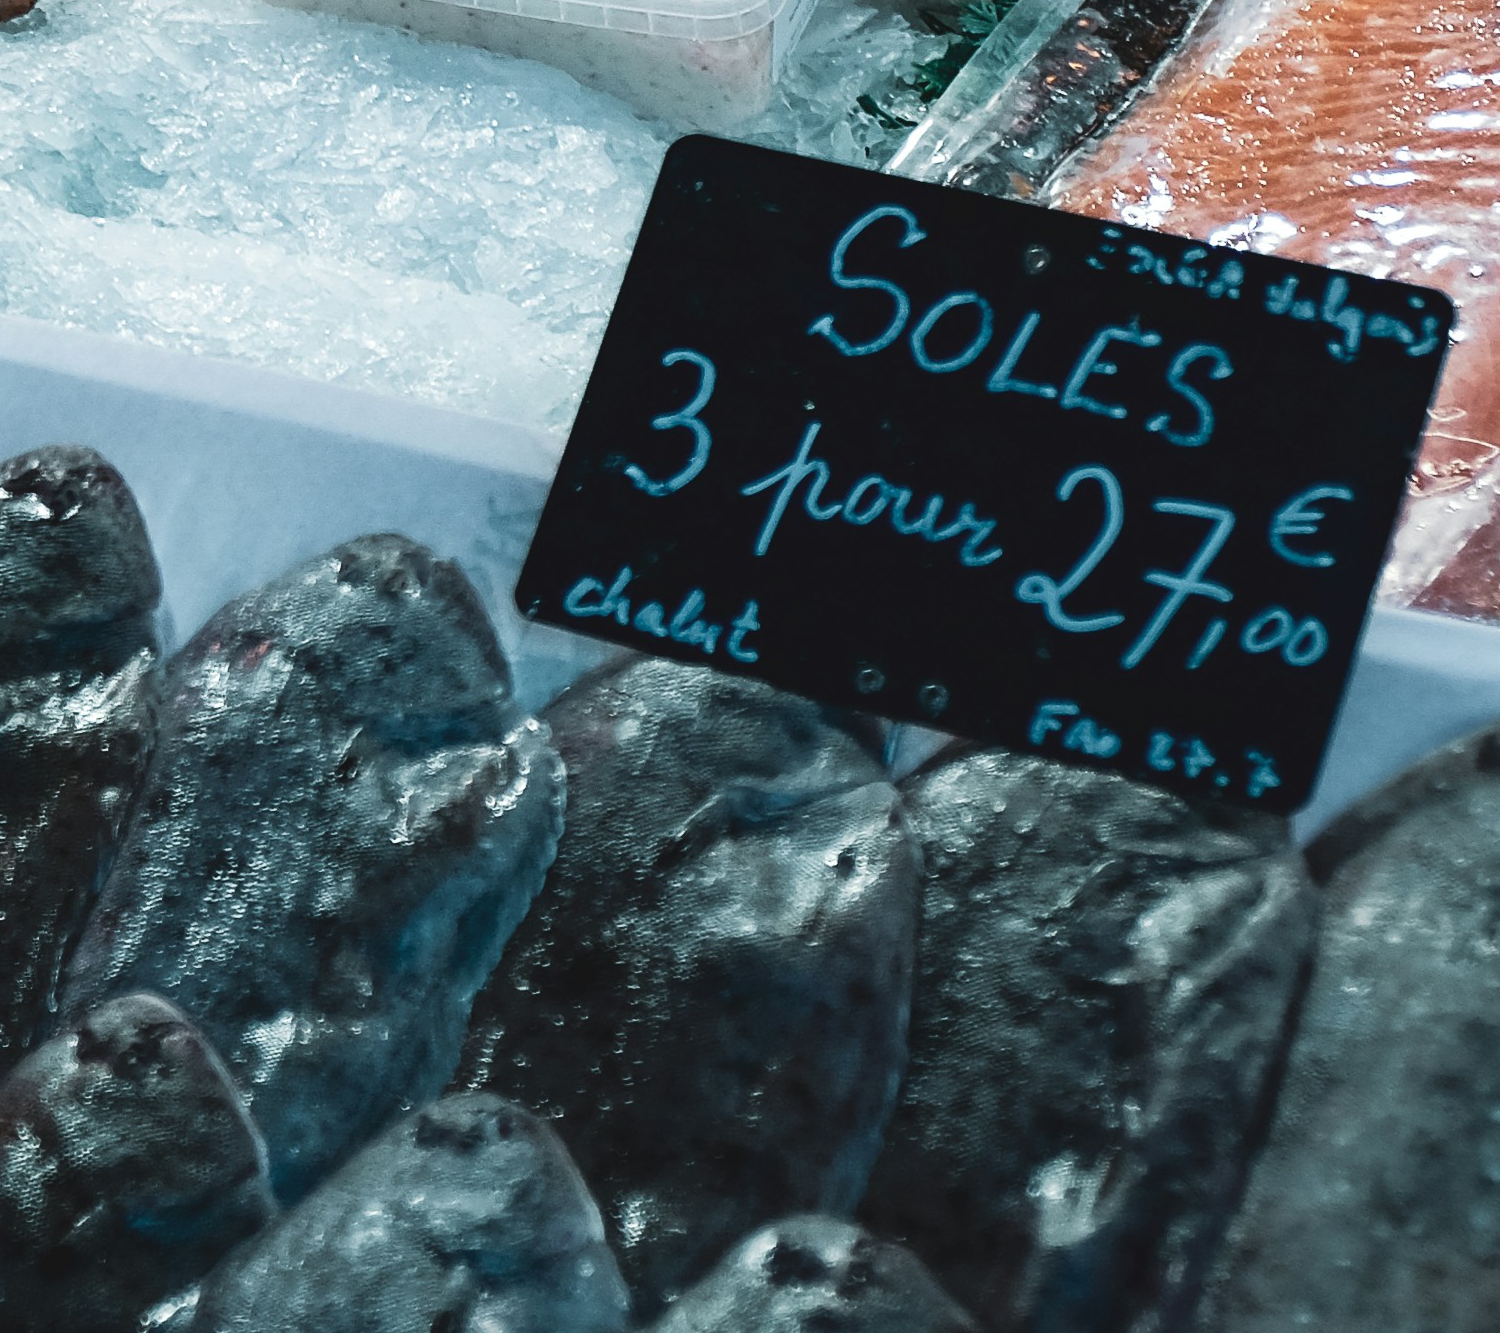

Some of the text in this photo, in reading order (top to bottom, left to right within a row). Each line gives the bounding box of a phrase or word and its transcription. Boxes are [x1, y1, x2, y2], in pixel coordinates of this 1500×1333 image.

[808, 203, 1235, 450] SOLES
[622, 348, 716, 498] 3
[741, 419, 1005, 567] pour
[1269, 483, 1356, 568] €
